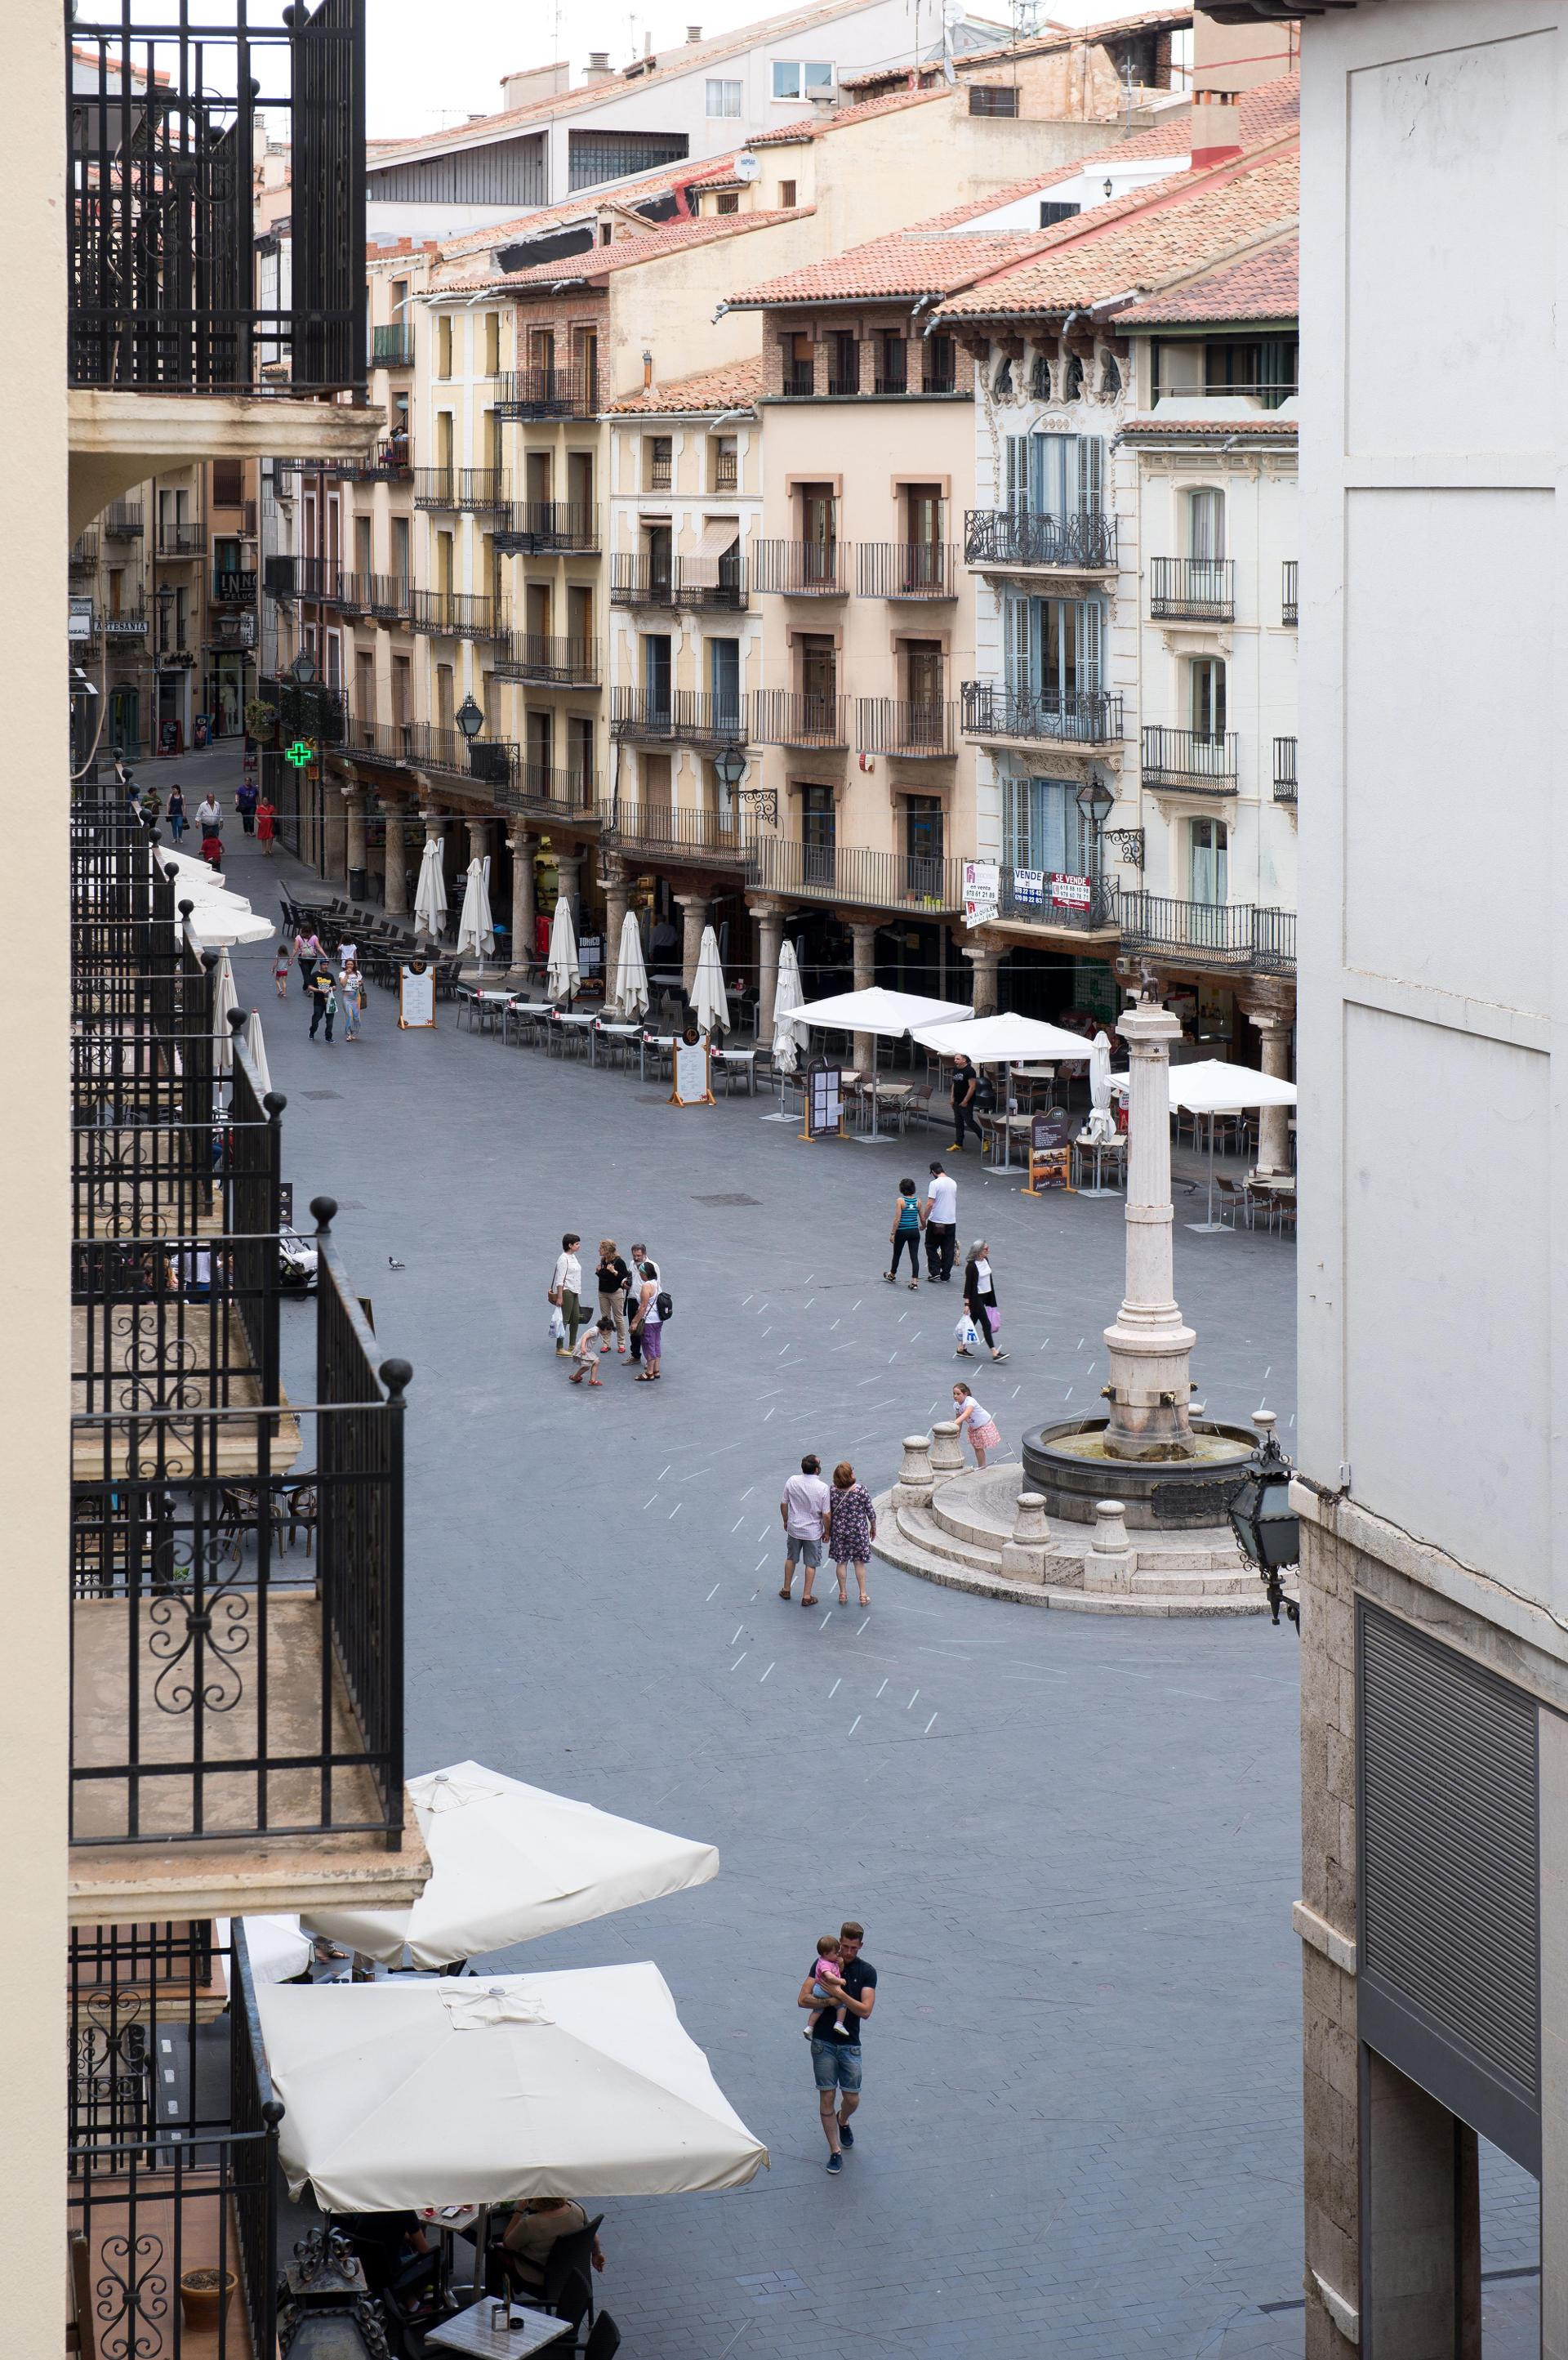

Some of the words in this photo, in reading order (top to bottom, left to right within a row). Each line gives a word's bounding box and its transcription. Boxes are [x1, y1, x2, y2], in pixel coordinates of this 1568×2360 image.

[96, 622, 145, 631] ARTESANIA
[1015, 869, 1042, 881] VENDE
[1055, 874, 1064, 883] SE
[1065, 875, 1087, 886] VENDE
